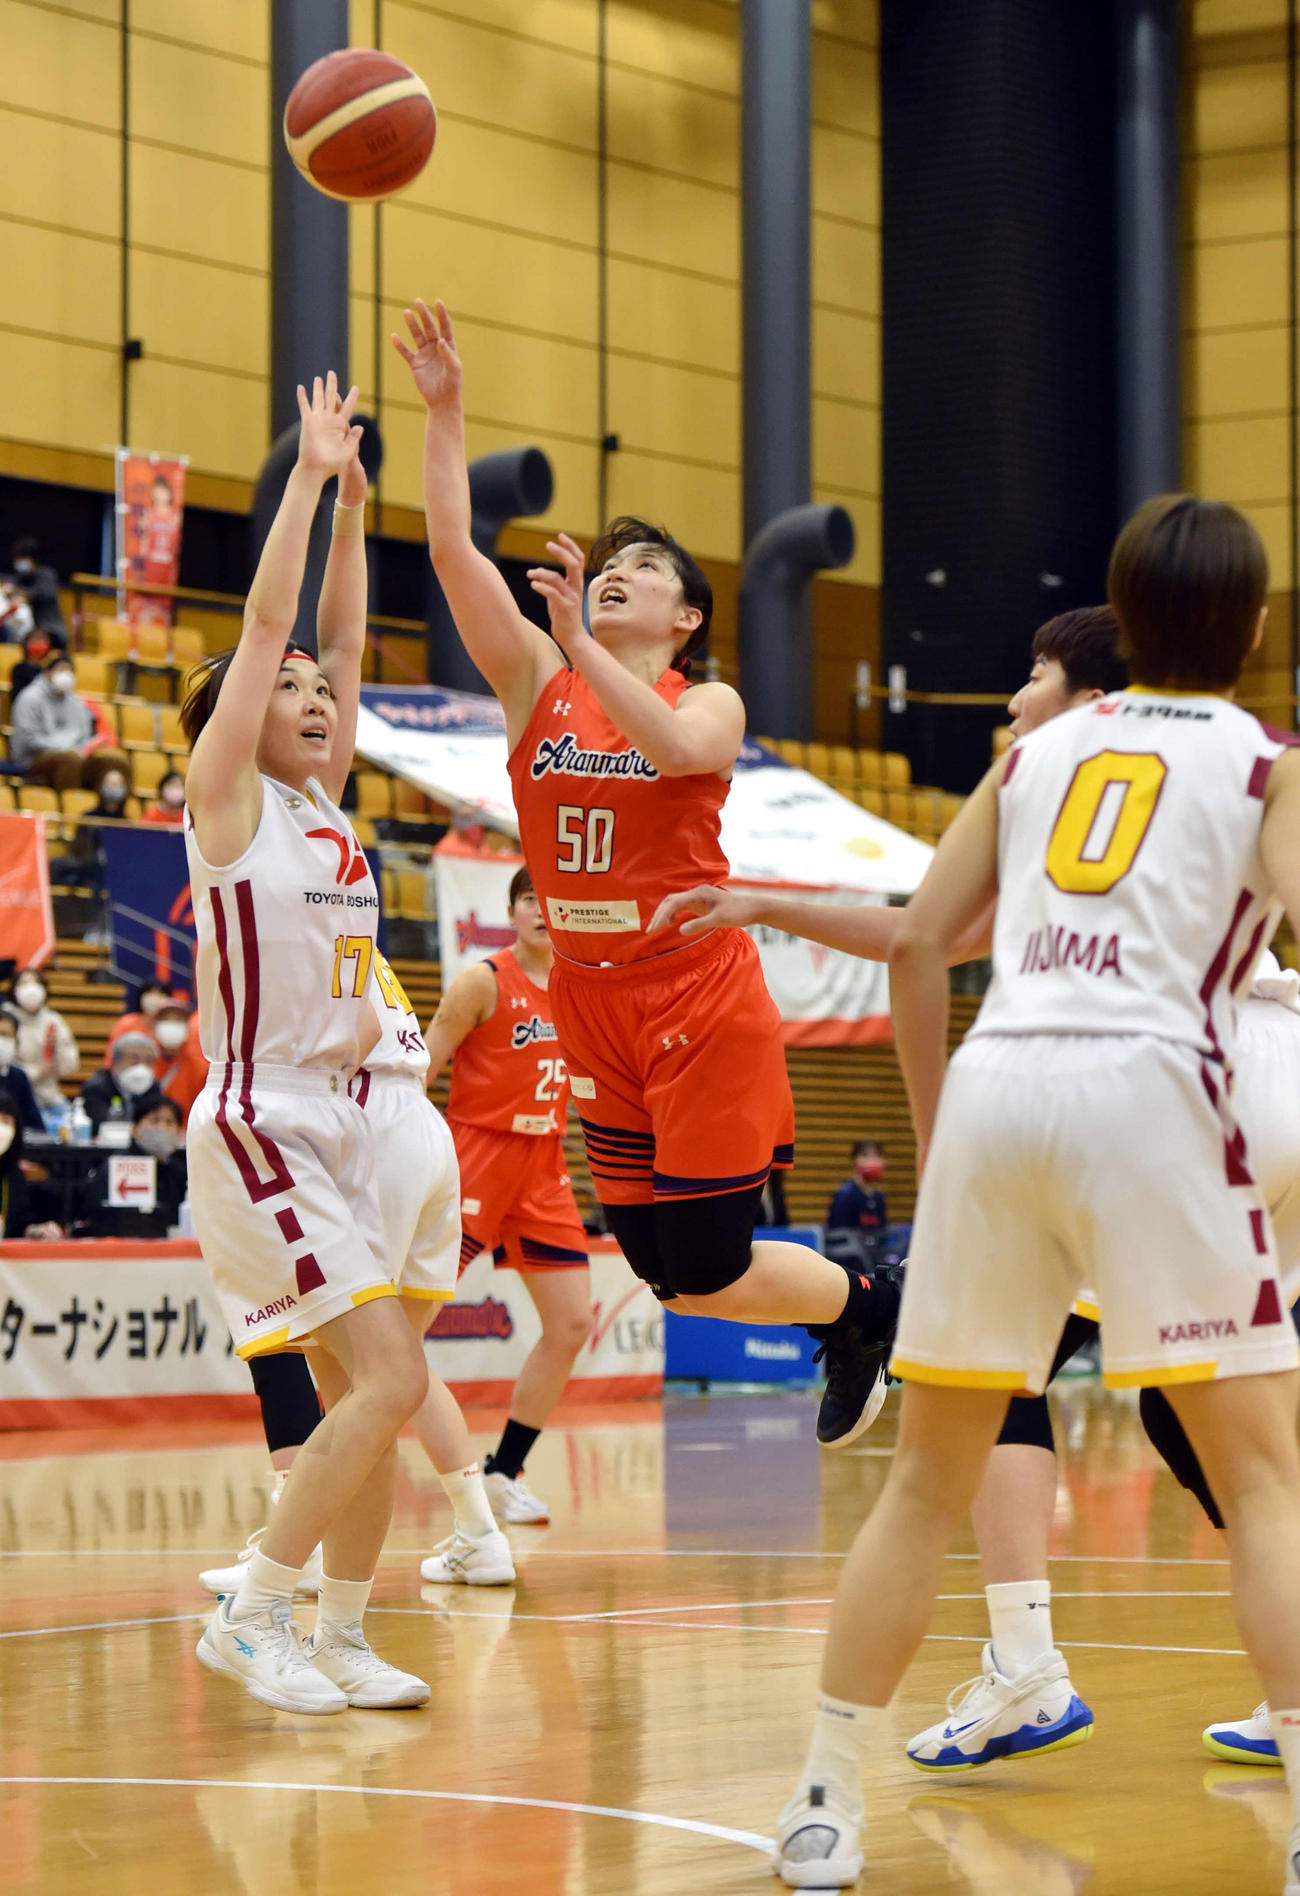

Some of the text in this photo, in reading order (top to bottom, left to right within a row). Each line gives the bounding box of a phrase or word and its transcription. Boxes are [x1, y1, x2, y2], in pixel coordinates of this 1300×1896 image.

[557, 803, 616, 874] 50
[1045, 749, 1168, 896] 0
[304, 892, 345, 906] TOYOTA
[570, 908, 609, 916] PRESTIGE
[572, 917, 628, 925] INTERNATIONAL
[331, 934, 373, 999] 17
[1019, 924, 1123, 977] IIJIMA
[535, 1058, 567, 1101] 25
[0, 1296, 207, 1361] ターナショナル
[244, 1294, 298, 1327] KARIYA
[1158, 1319, 1240, 1344] KARIYA
